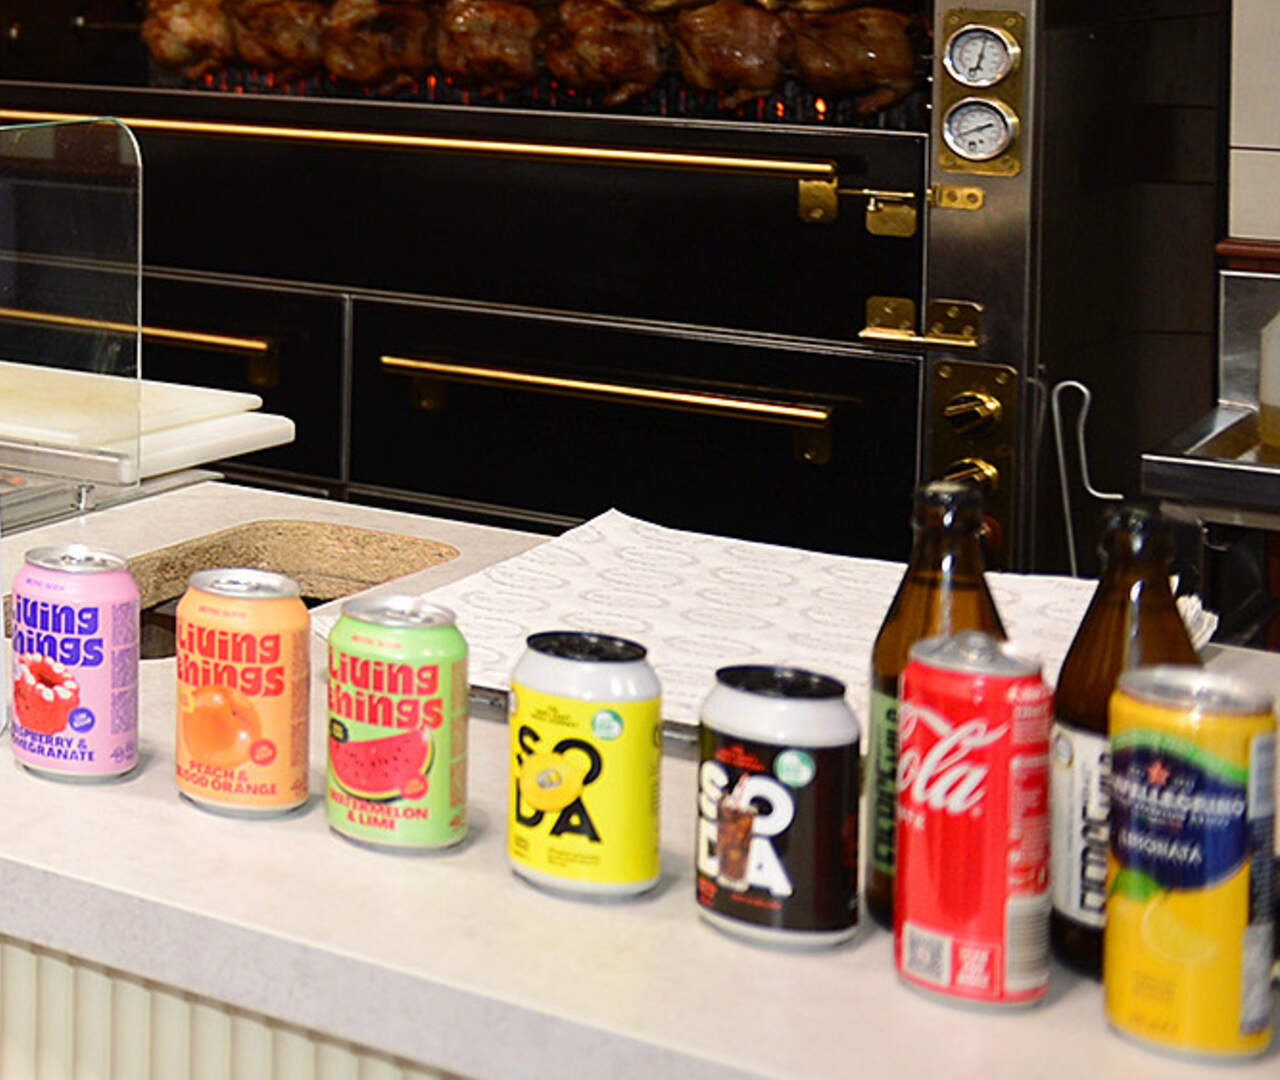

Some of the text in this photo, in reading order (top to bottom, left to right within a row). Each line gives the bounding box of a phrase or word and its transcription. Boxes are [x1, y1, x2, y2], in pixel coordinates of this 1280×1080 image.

[14, 594, 100, 636] iving
[12, 627, 104, 667] hings
[76, 738, 88, 750] &
[189, 759, 248, 782] PEACH &
[211, 778, 277, 795] ORANGE
[1114, 775, 1246, 817] PELLEGRINO
[347, 807, 396, 830] & LIME
[1118, 828, 1203, 866] LIMONATA
